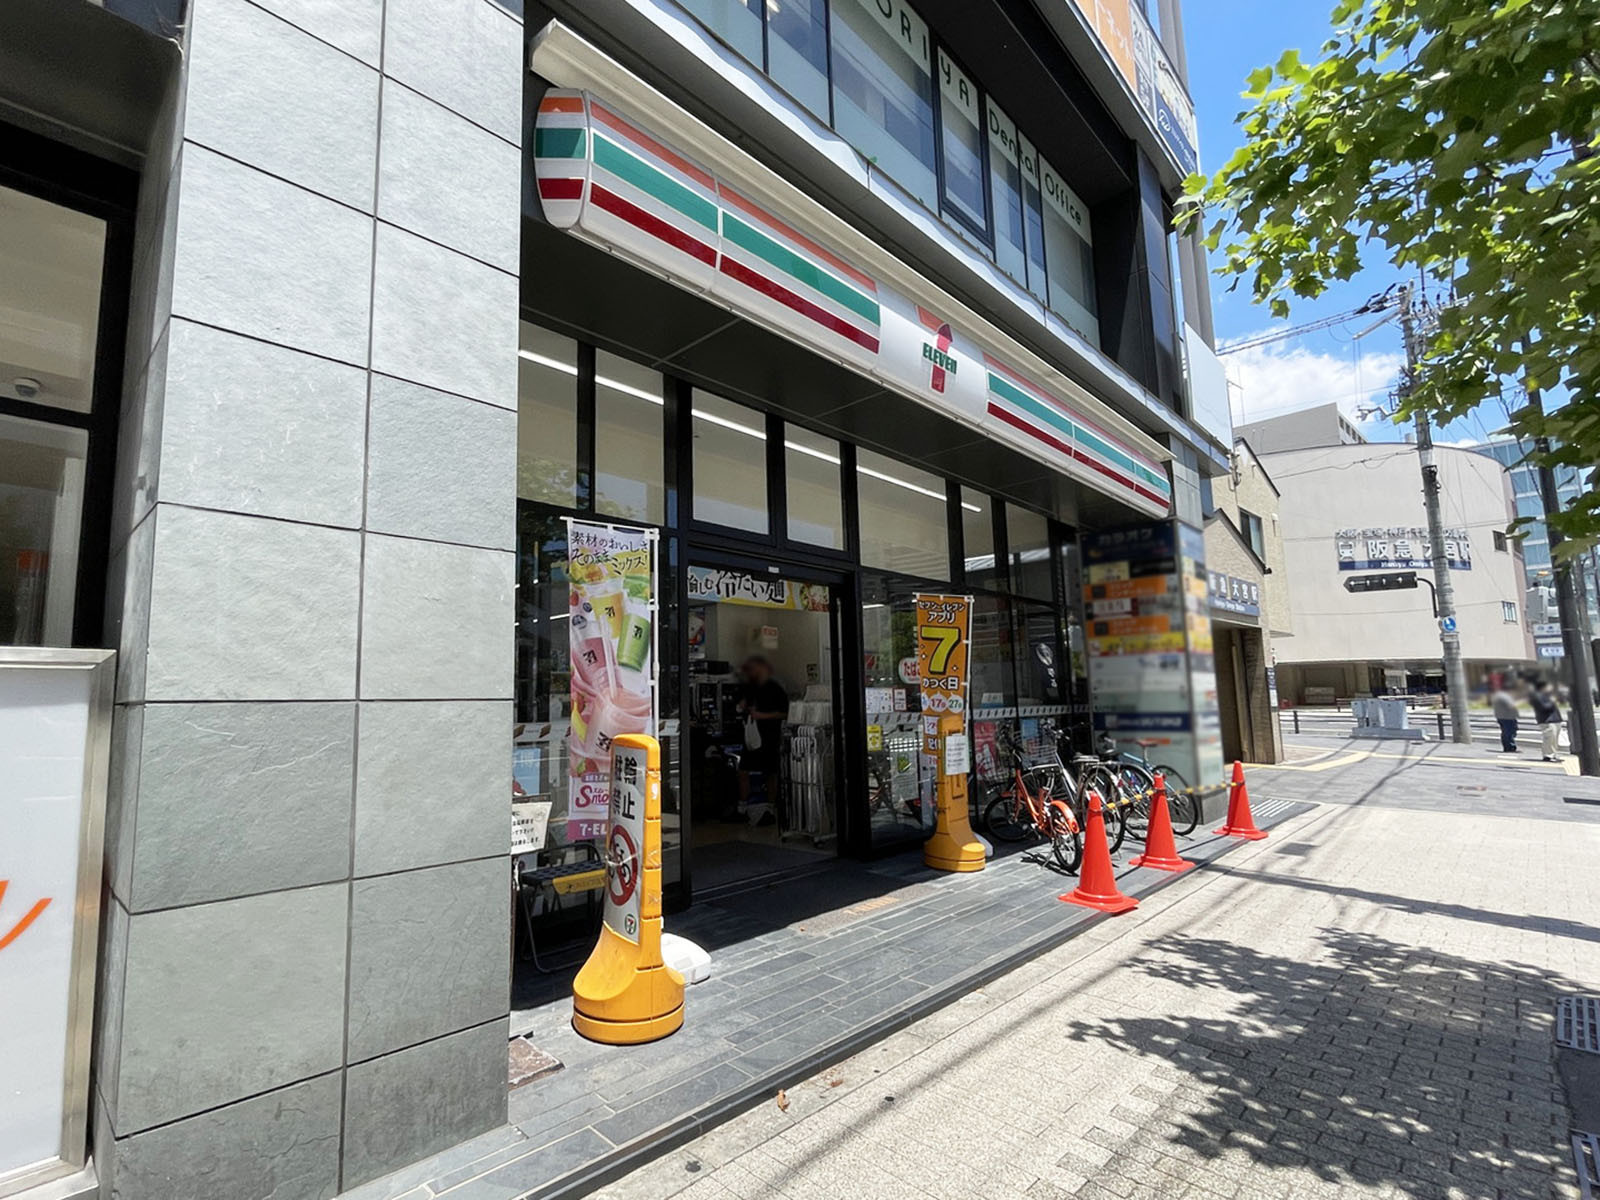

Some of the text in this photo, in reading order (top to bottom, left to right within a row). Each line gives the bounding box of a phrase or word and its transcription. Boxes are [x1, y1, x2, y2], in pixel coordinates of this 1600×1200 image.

[989, 108, 1038, 178] Dental
[1043, 172, 1083, 227] Office
[927, 611, 956, 623] アプリ
[920, 625, 961, 674] 7
